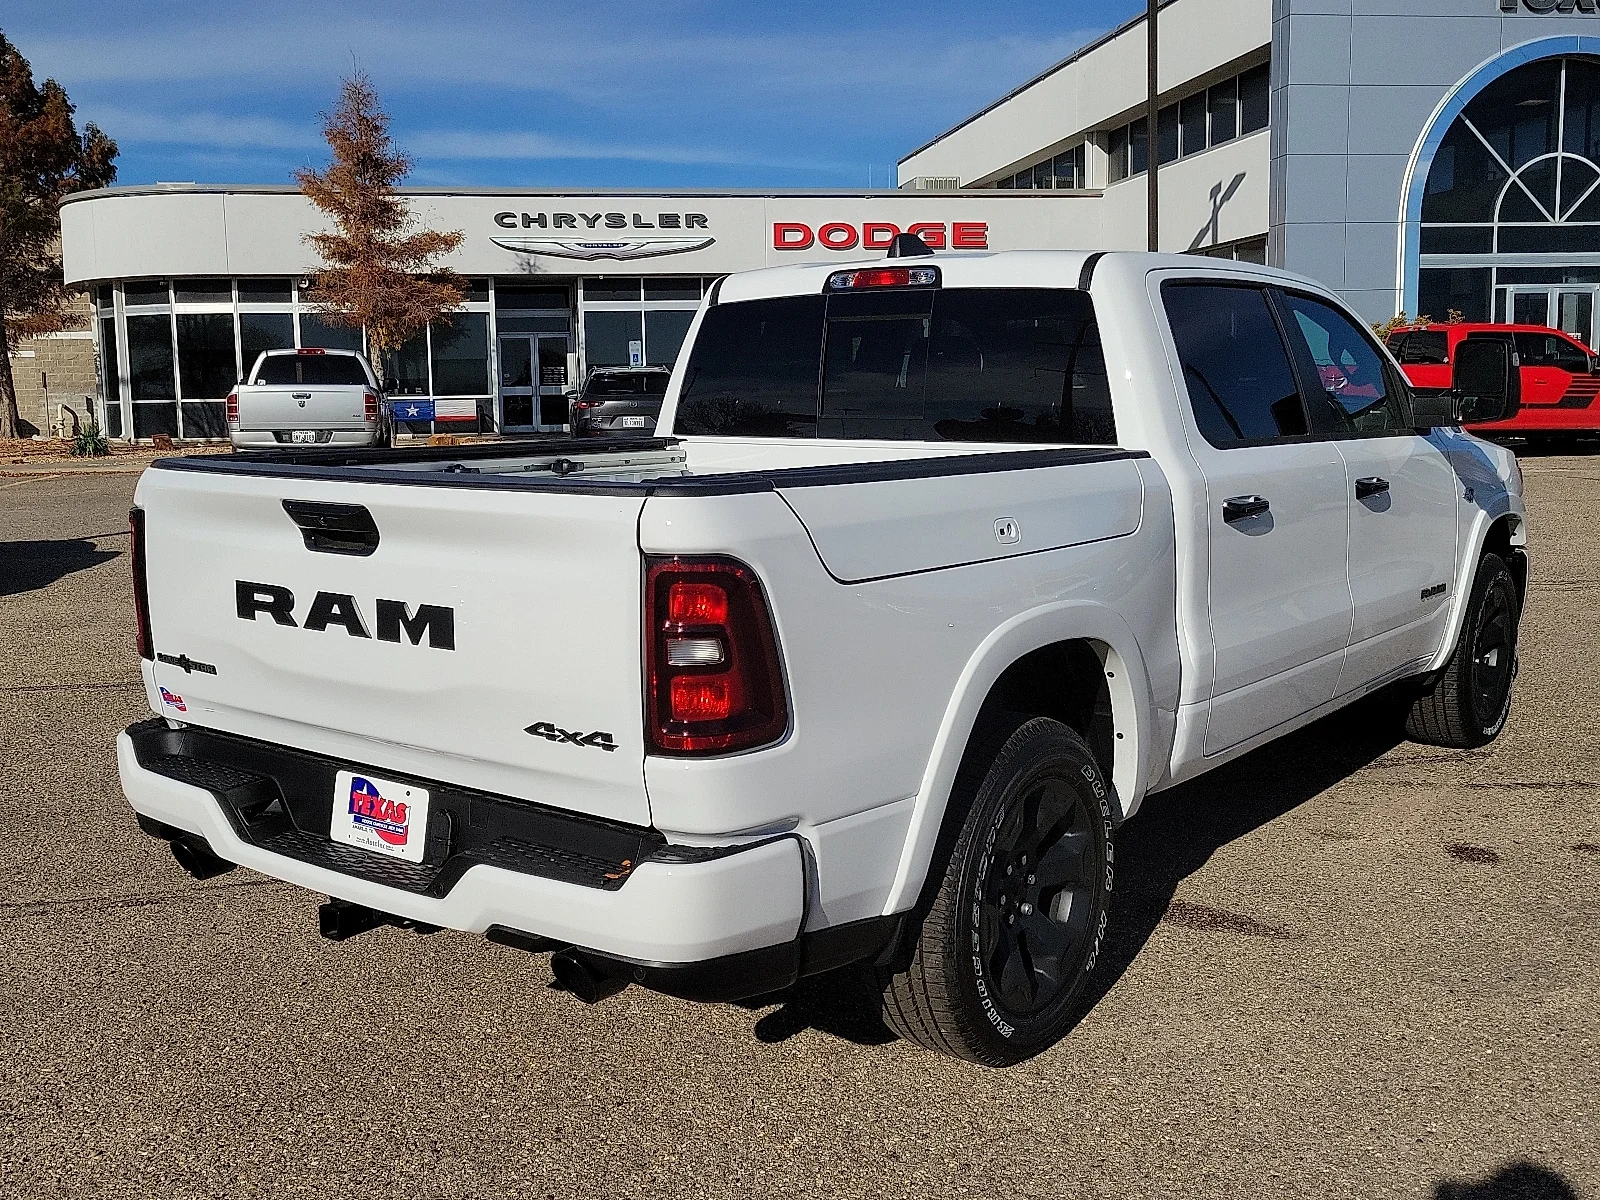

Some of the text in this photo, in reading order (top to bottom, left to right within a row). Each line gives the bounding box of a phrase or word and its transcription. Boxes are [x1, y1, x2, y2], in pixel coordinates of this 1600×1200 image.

[494, 213, 709, 229] CHRYSLER
[773, 222, 989, 250] DODGE
[235, 579, 456, 651] RAM
[522, 721, 620, 753] 4x4
[352, 791, 408, 825] TEXAS
[1080, 764, 1115, 893] DUELER
[967, 802, 1016, 1039] BRIDGESTONE
